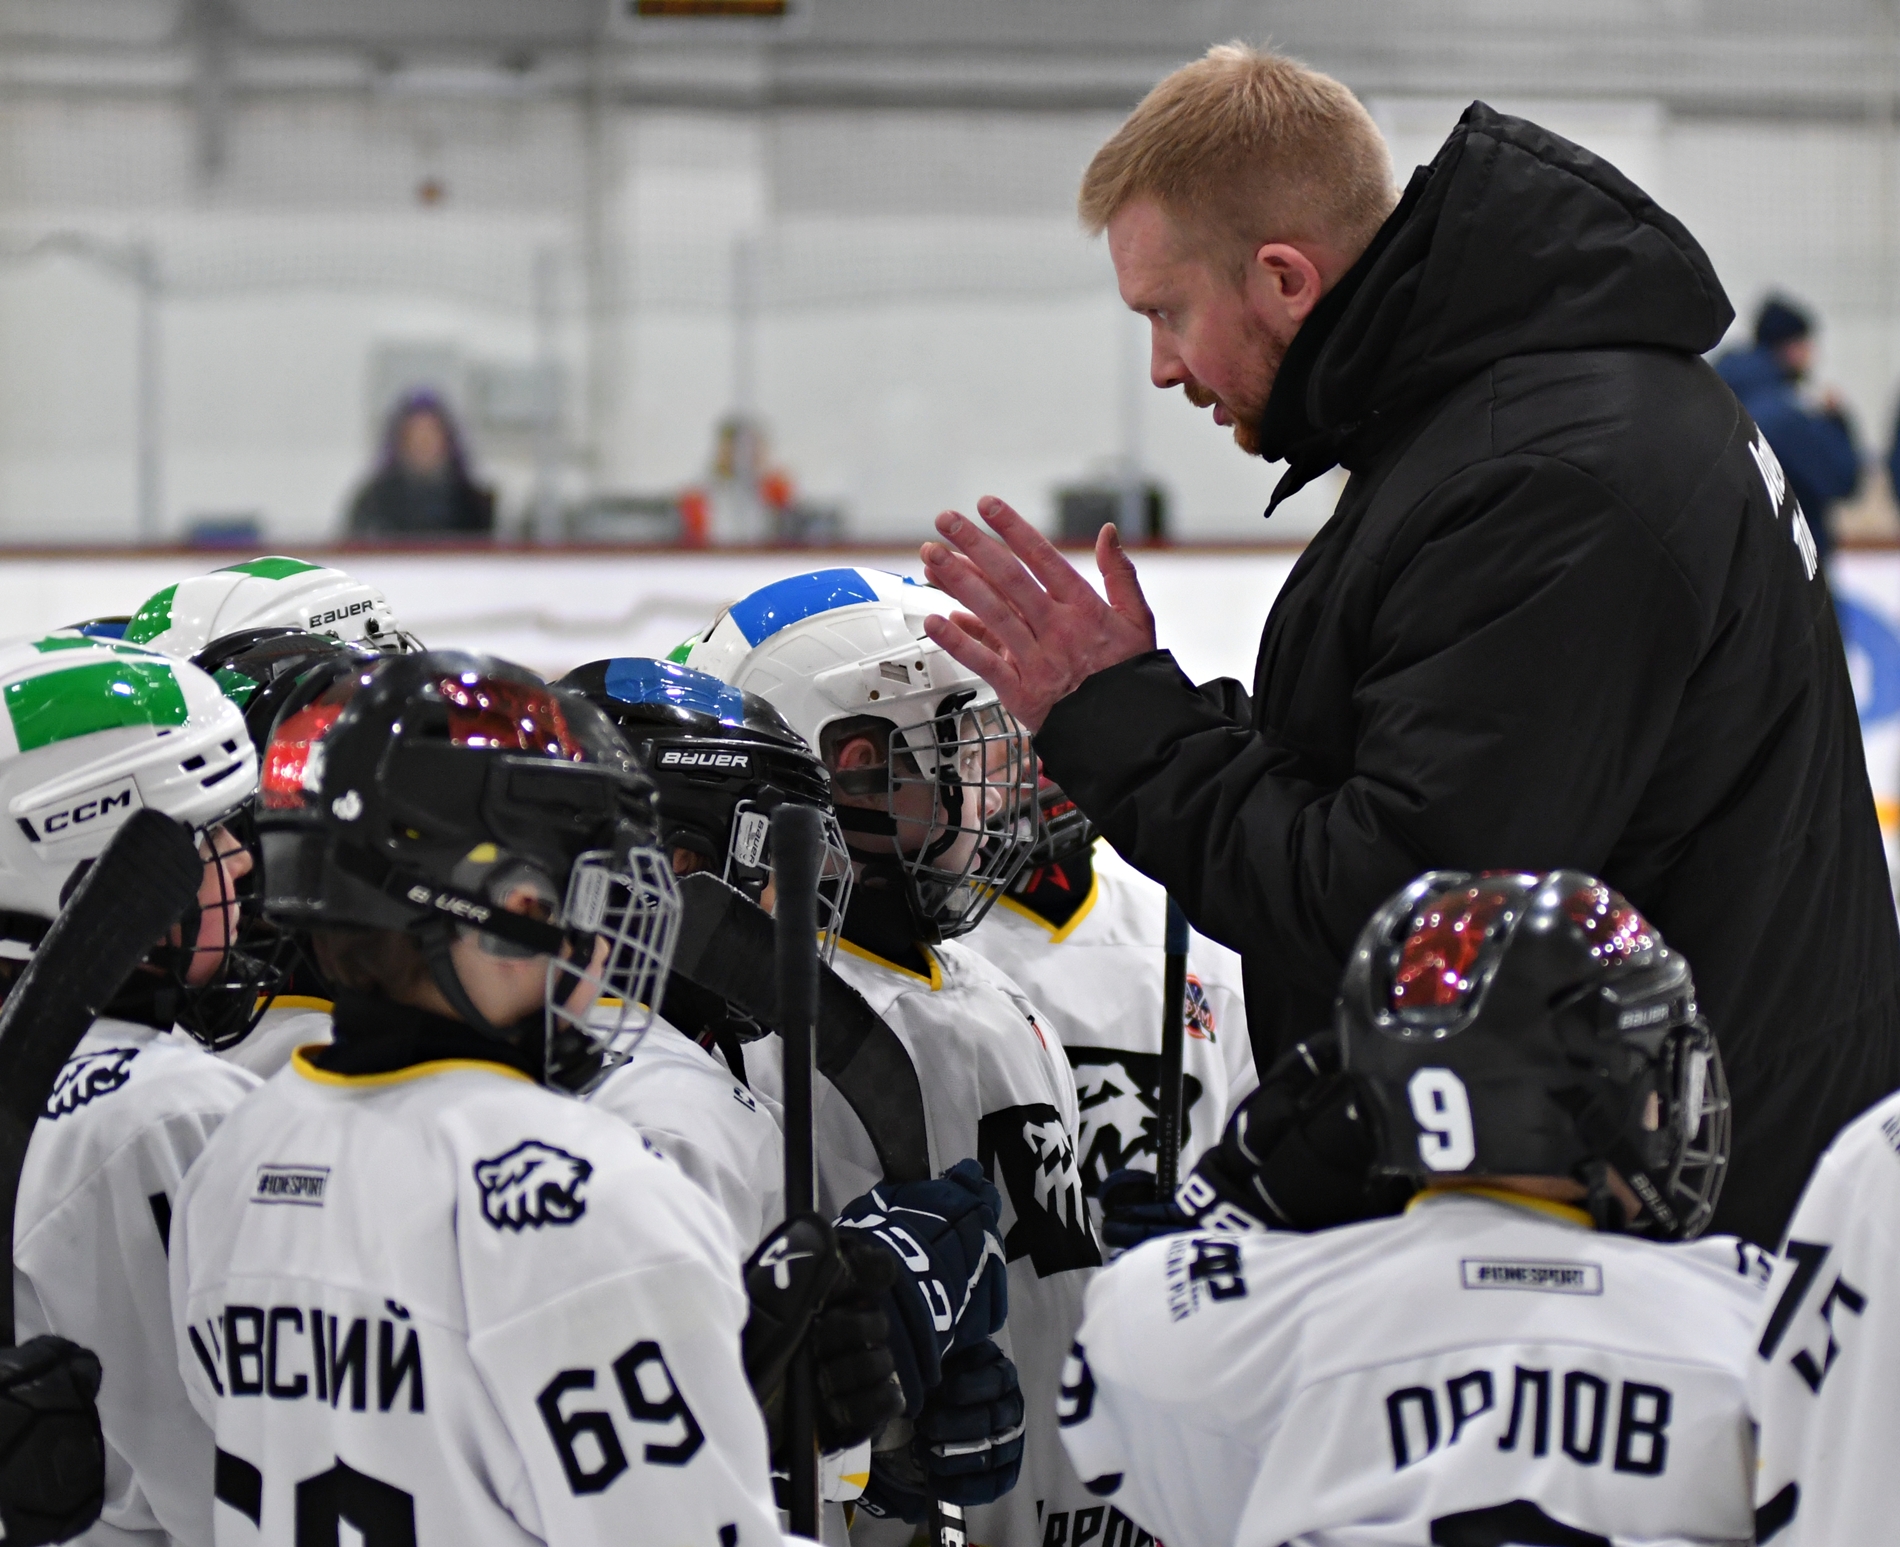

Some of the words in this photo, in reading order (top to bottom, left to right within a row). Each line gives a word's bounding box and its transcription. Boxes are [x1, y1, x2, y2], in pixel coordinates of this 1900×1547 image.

[309, 600, 374, 628] BAUER
[661, 752, 749, 768] BAUER
[44, 789, 131, 833] CCM
[406, 885, 491, 924] BUER
[1406, 1067, 1476, 1172] 9
[536, 1340, 706, 1497] 69
